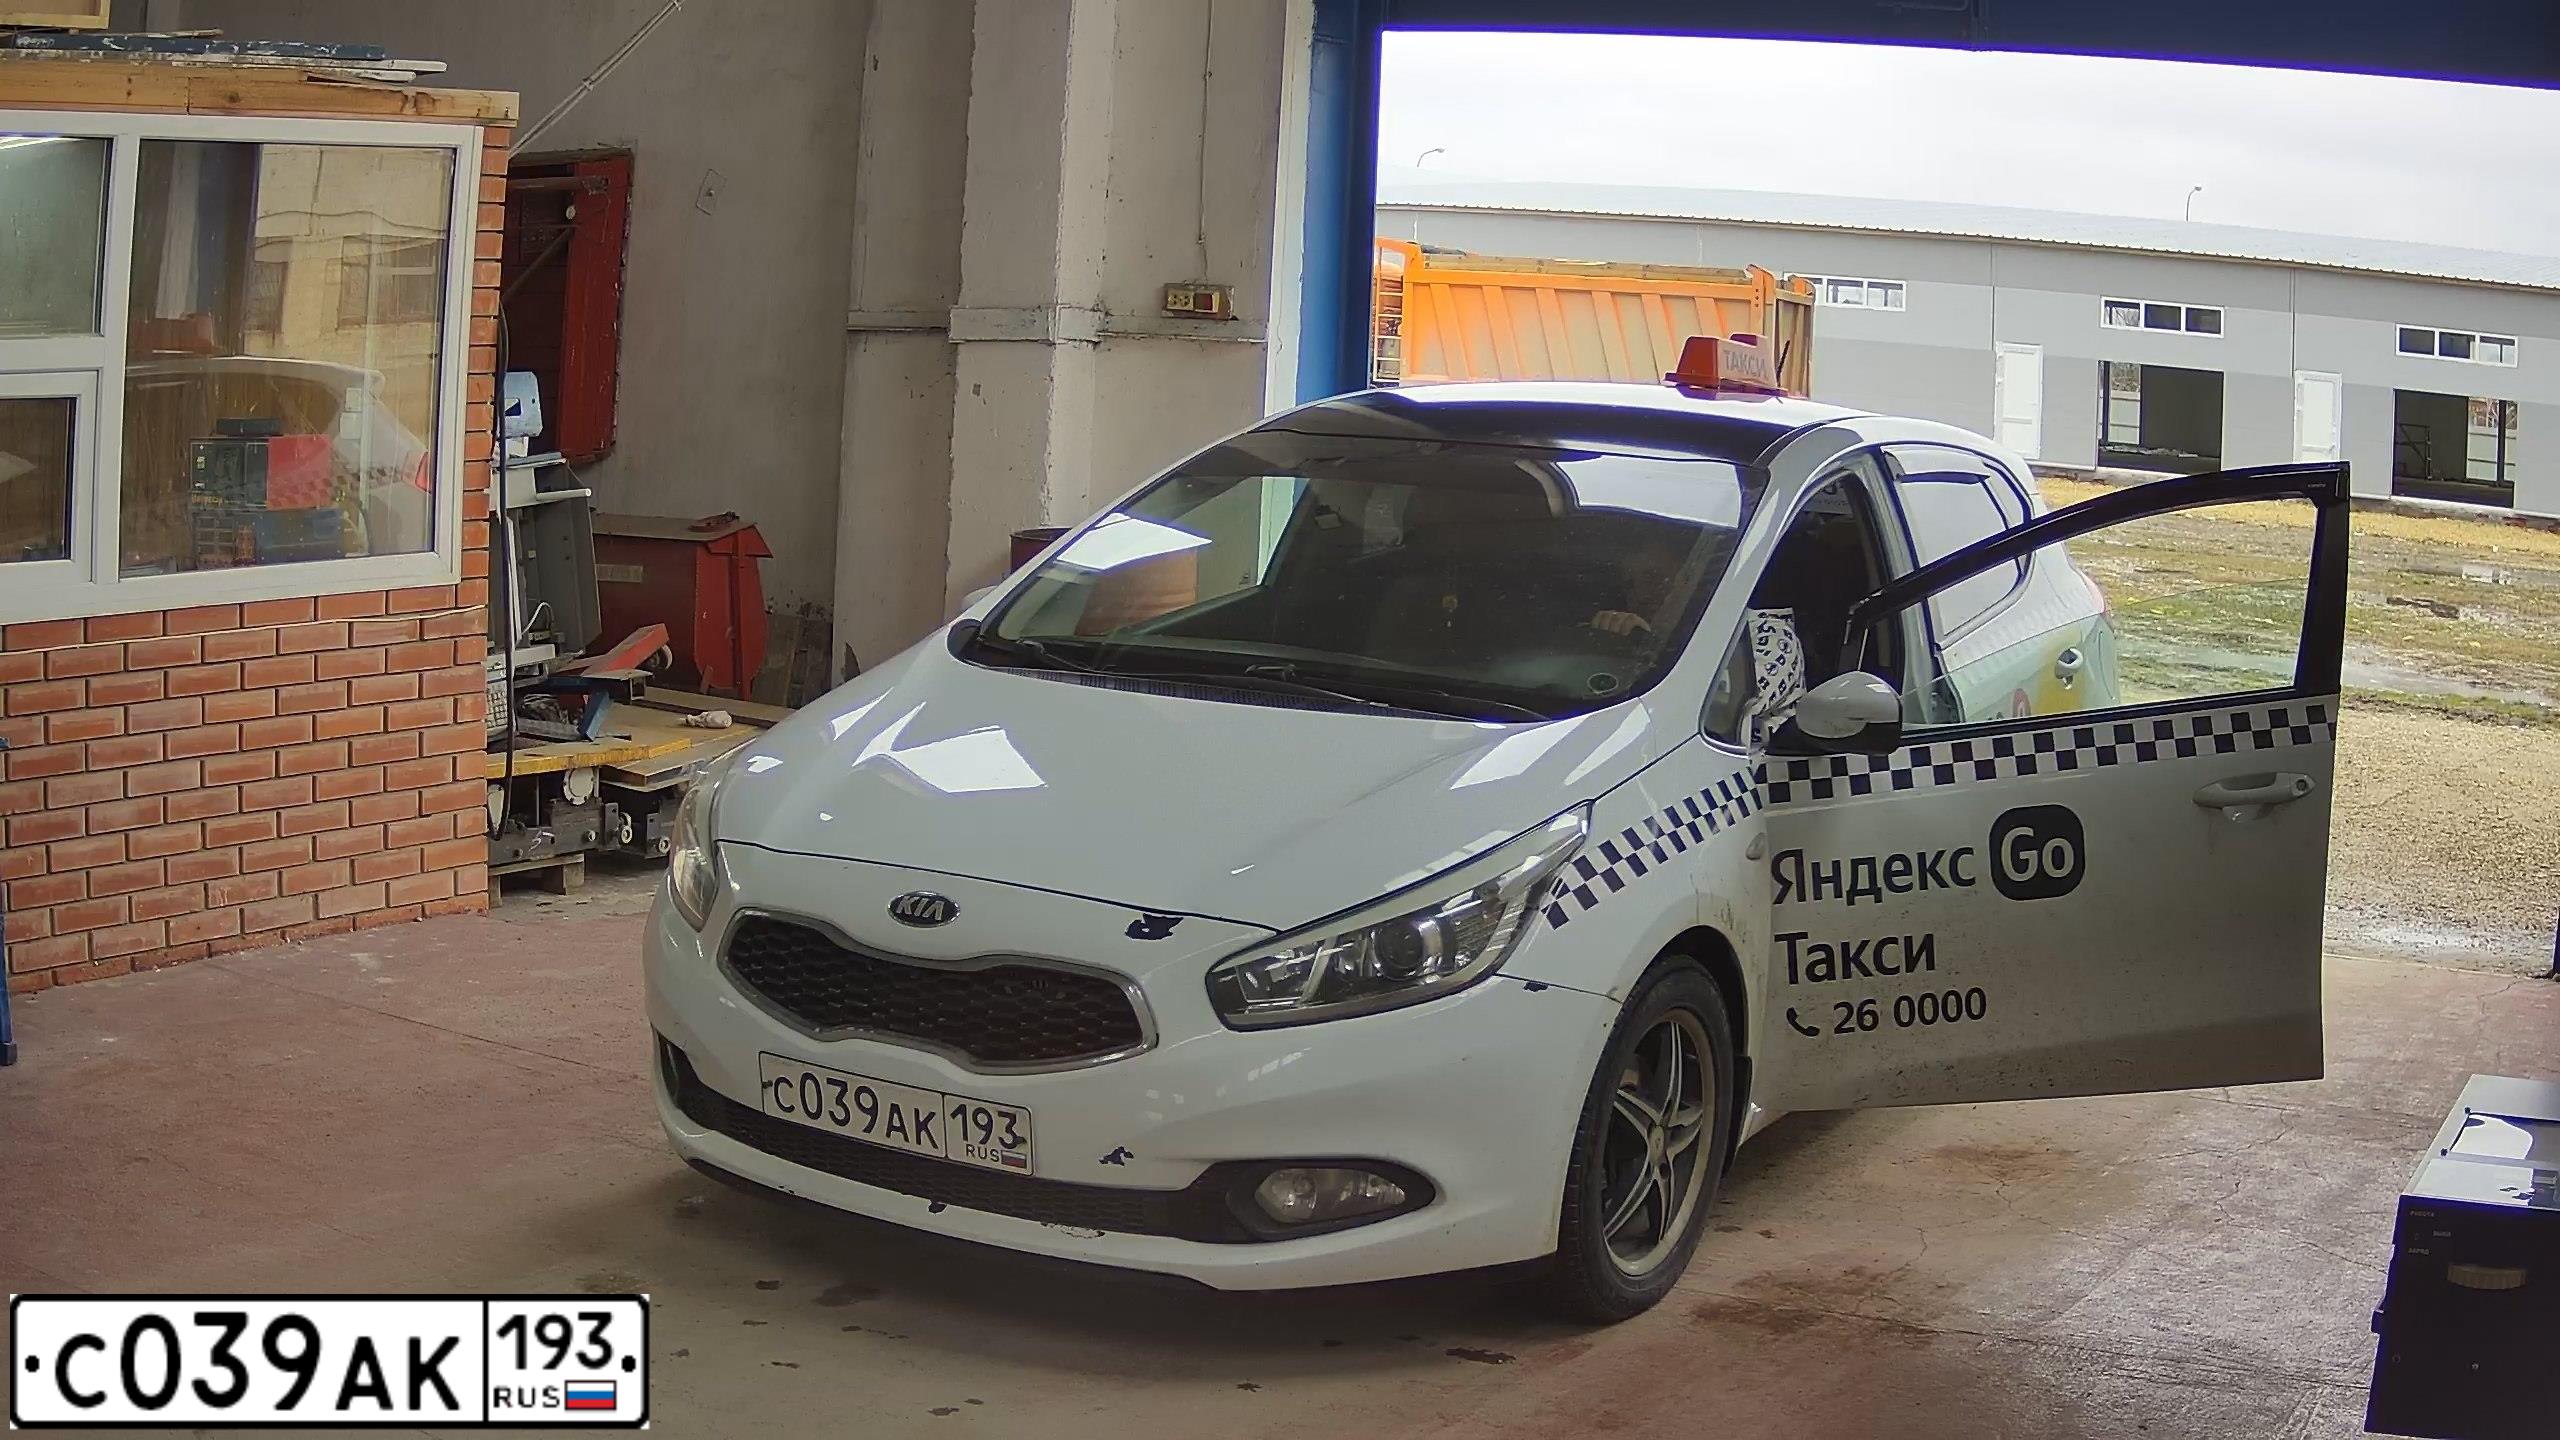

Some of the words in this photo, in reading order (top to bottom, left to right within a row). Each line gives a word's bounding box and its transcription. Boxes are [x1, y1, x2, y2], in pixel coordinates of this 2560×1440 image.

[1722, 350, 1767, 379] ТАКСИ
[1771, 847, 1976, 906] Яндекс
[2001, 827, 2074, 882] Go
[1774, 932, 1936, 985] Такси
[1833, 999, 1879, 1034] 26
[1894, 987, 1987, 1028] 0000
[965, 1143, 1000, 1162] RUS
